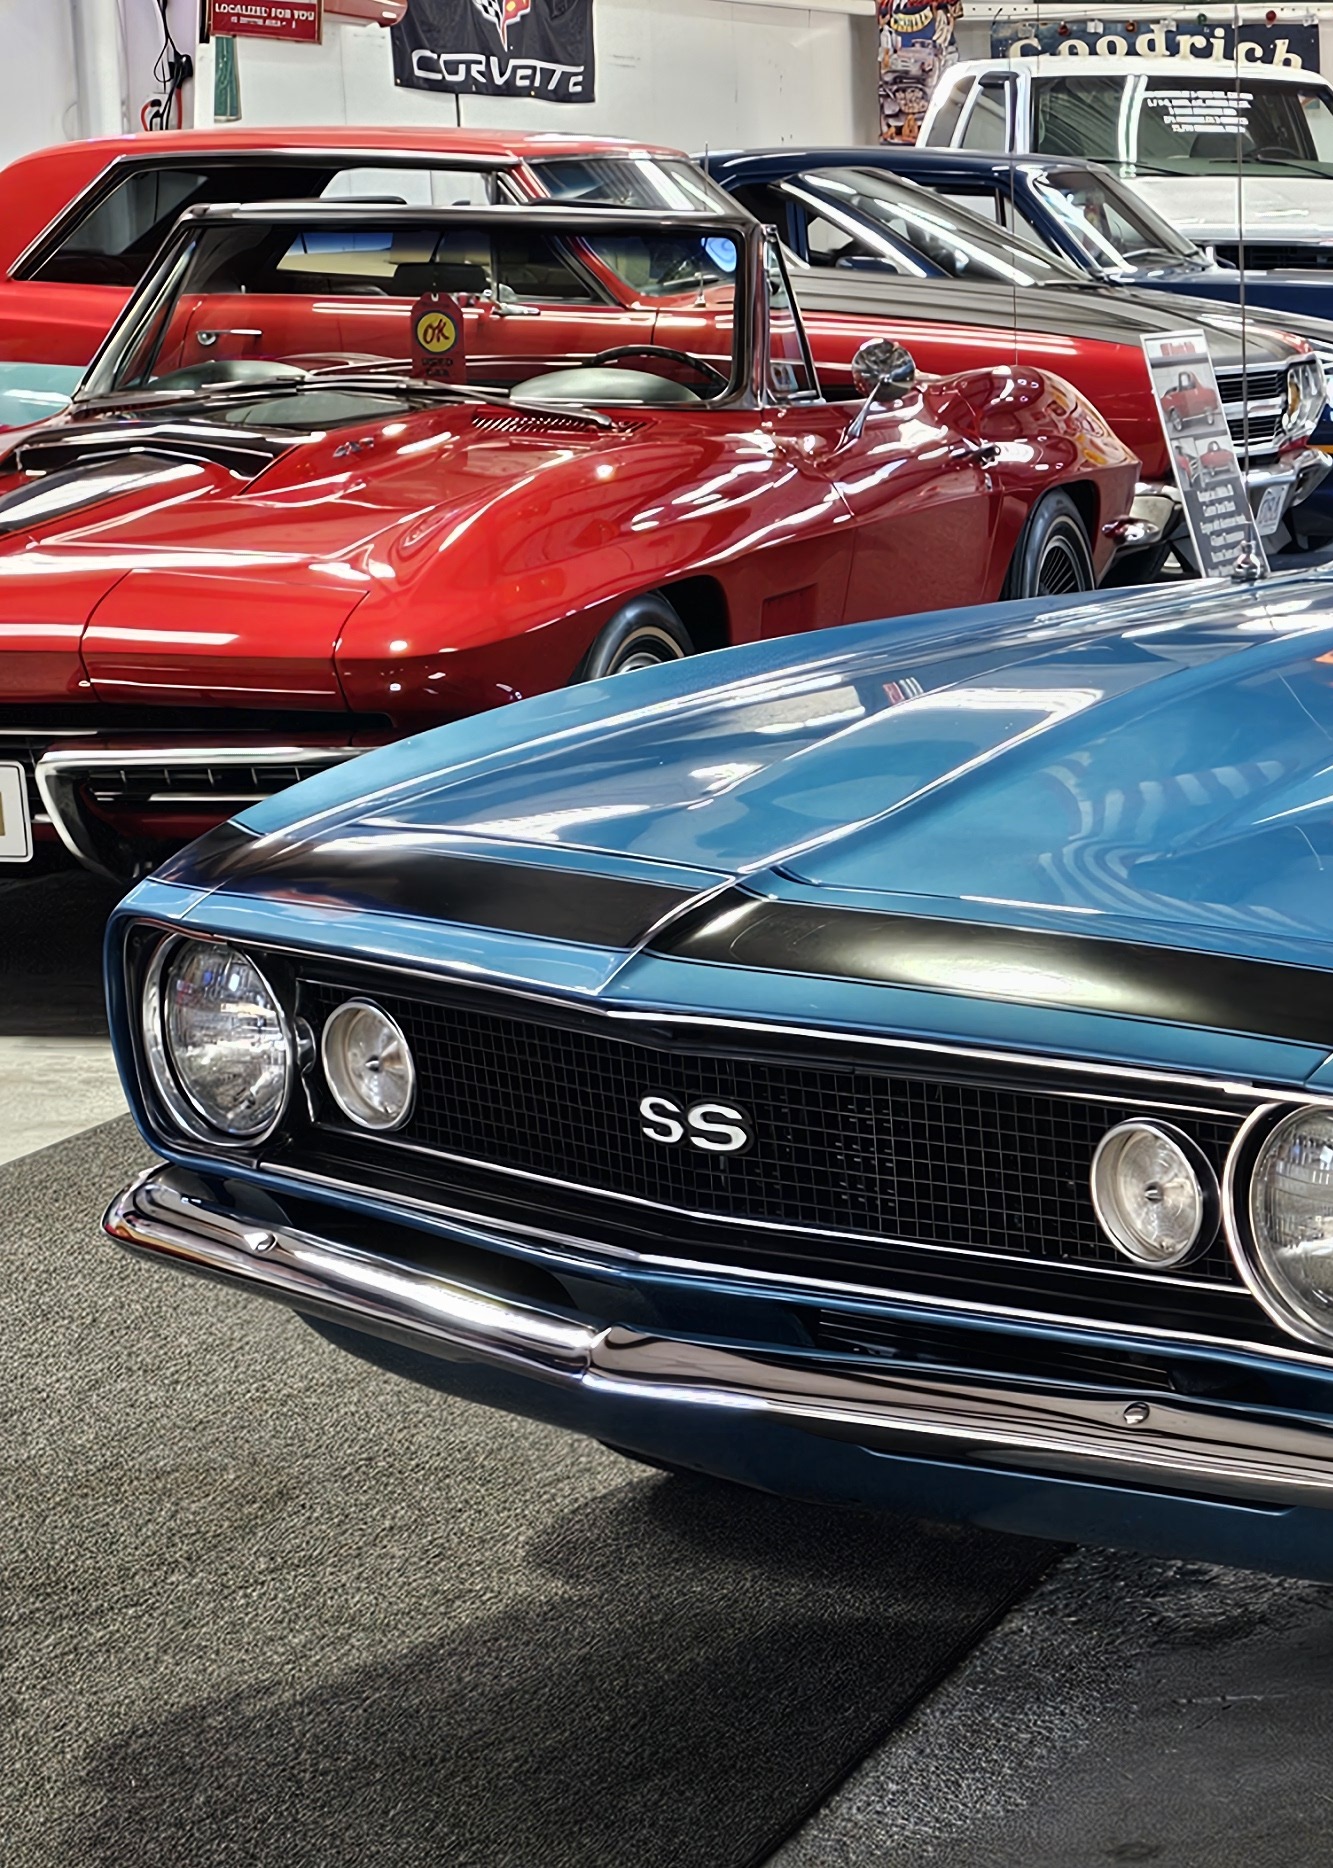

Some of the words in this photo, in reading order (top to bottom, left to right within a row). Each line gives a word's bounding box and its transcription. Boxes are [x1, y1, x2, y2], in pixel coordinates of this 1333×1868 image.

[215, 3, 268, 17] LOCALIZED
[271, 7, 291, 19] FOR
[293, 9, 314, 20] YOU
[1009, 25, 1303, 69] Goodrich
[411, 49, 585, 93] CORVETTE
[422, 318, 450, 345] OK
[639, 1096, 748, 1151] SS
